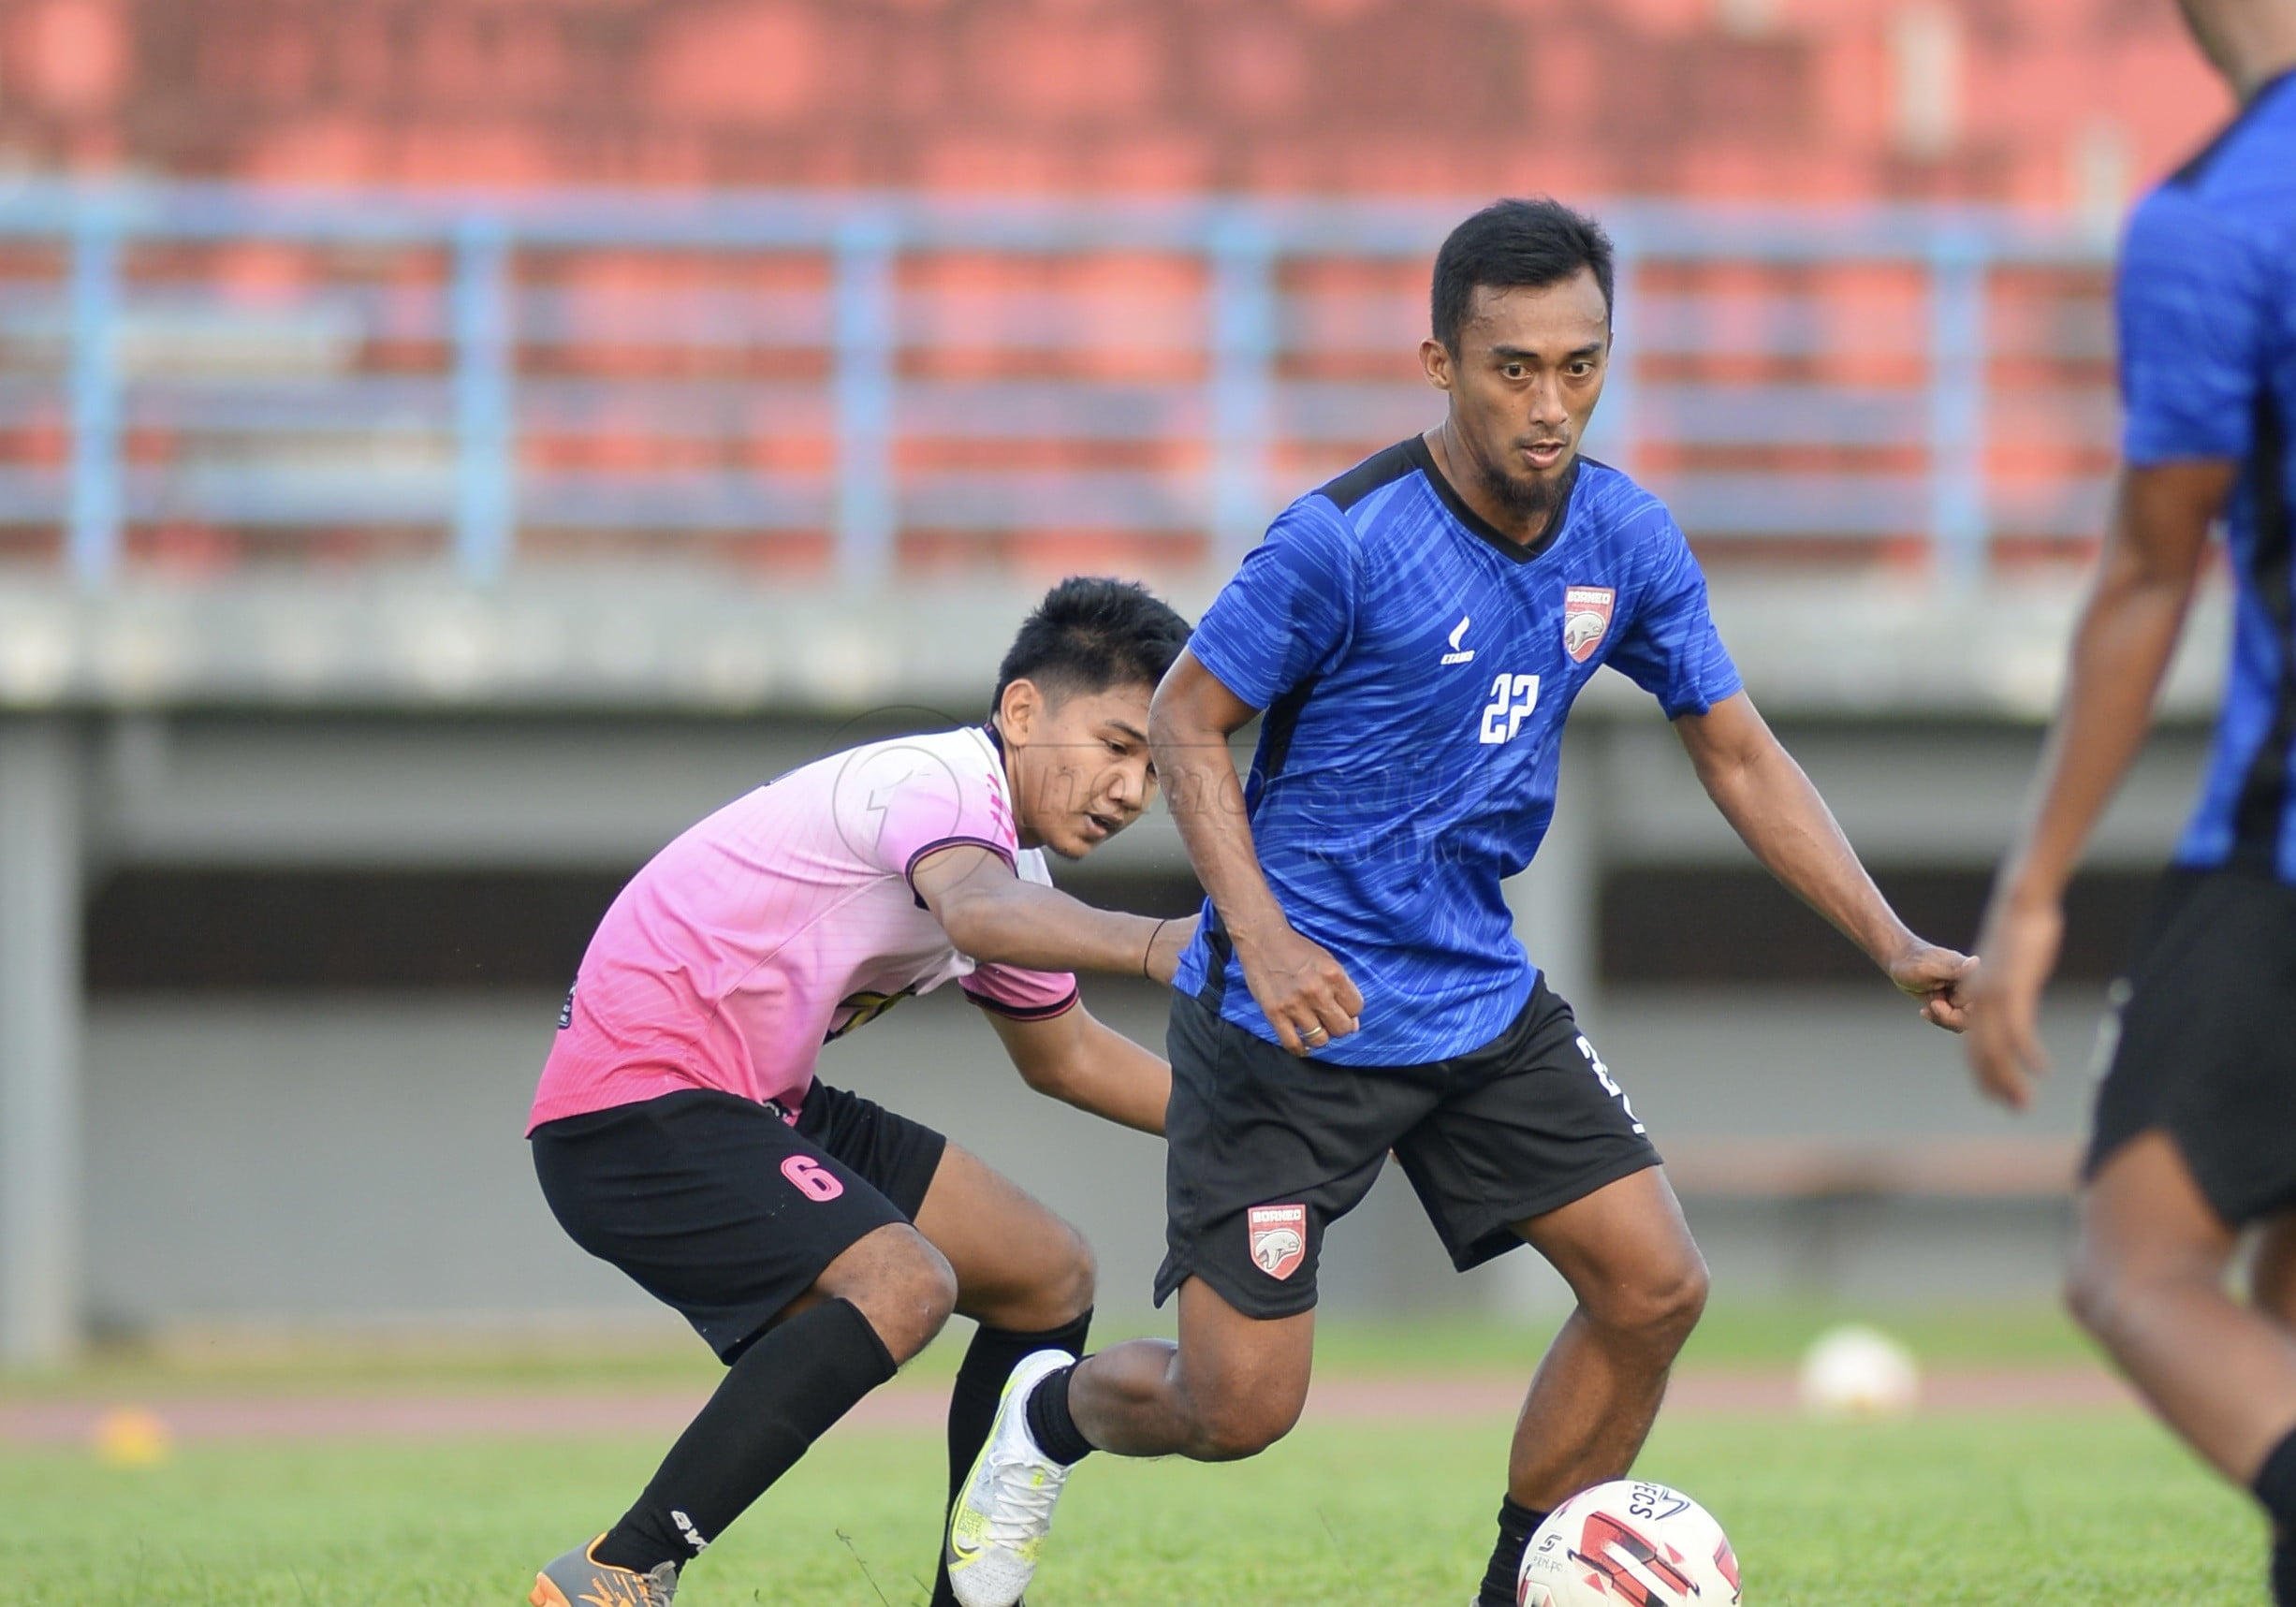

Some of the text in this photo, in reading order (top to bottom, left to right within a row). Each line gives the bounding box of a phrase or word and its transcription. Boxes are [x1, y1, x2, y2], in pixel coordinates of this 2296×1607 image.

[1567, 591, 1611, 605] BORNEO
[1480, 673, 1540, 744] 22
[780, 1154, 844, 1203] 6
[1252, 1208, 1302, 1224] BORNEO
[1630, 1483, 1658, 1519] ECS
